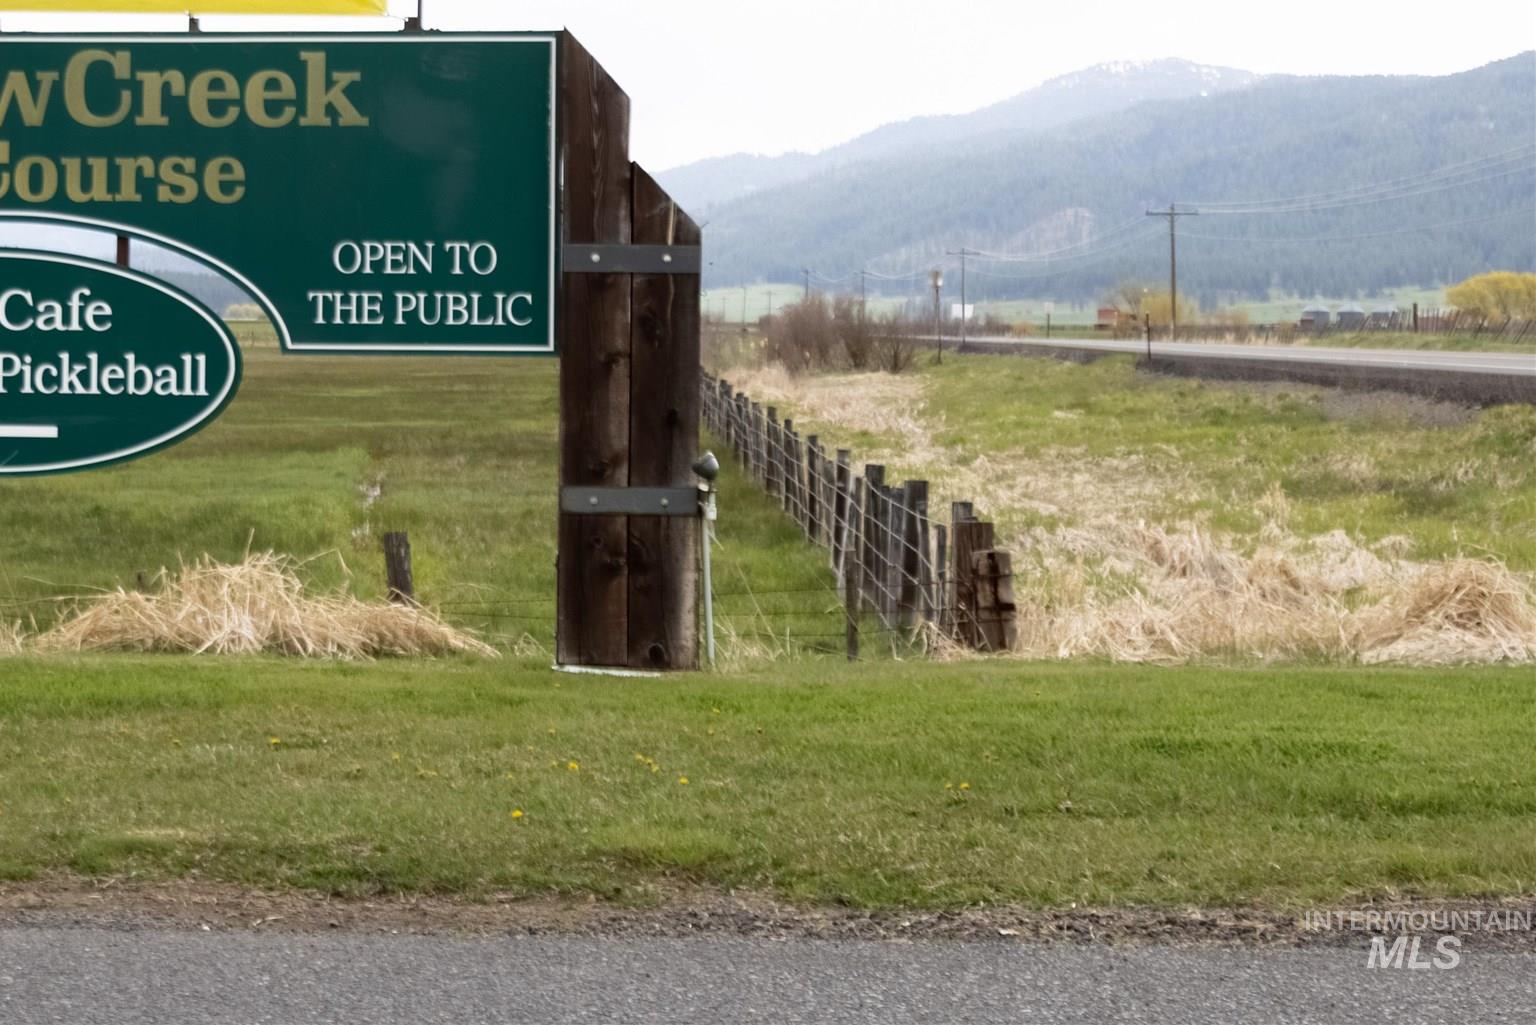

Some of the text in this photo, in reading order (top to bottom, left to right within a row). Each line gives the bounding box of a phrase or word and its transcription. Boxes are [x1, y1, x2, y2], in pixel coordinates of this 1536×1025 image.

[332, 240, 498, 276] OPEN TO
[308, 291, 534, 327] THE PUBLIC
